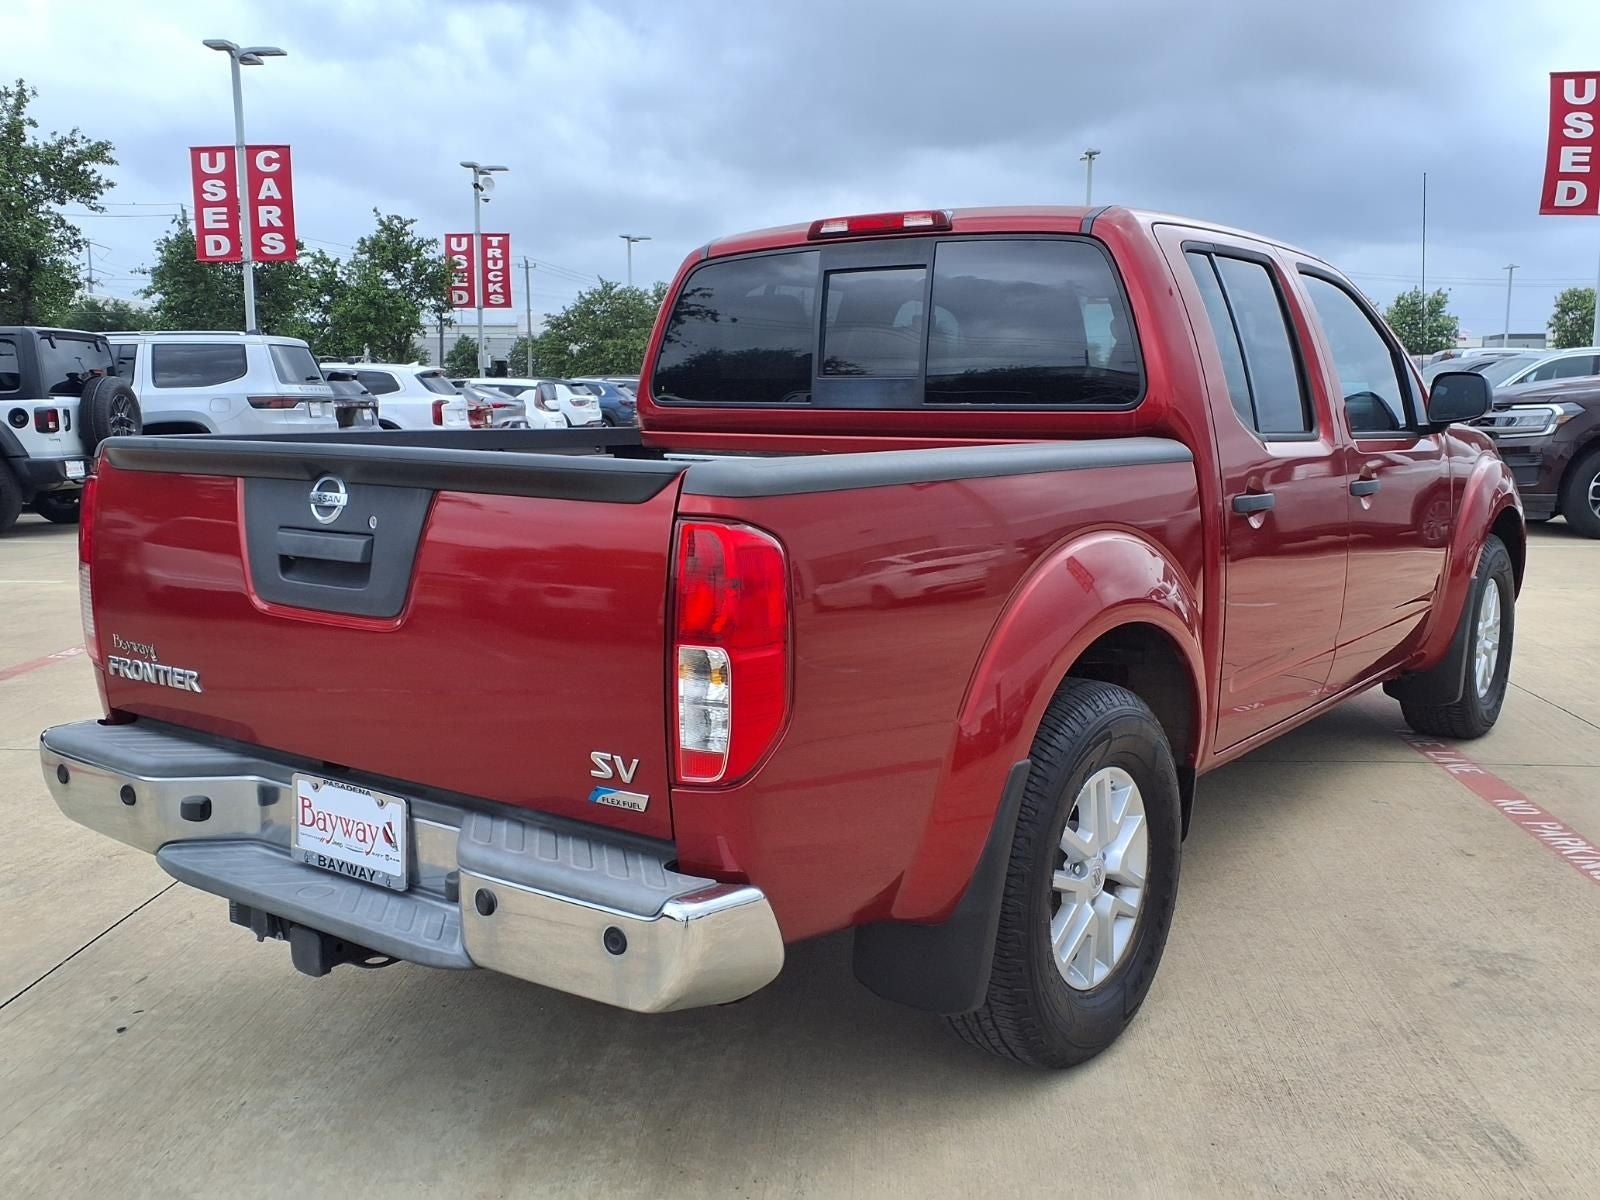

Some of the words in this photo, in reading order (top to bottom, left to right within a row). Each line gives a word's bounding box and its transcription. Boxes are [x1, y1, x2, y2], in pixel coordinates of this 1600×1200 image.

[1553, 78, 1597, 207] USED
[200, 152, 231, 257] USED
[255, 150, 287, 255] CARS
[450, 237, 470, 305] USED
[486, 236, 505, 304] TRUCKS
[108, 655, 202, 693] FRONTIER
[323, 780, 371, 797] PASADENA
[590, 751, 640, 784] SV
[299, 796, 379, 856] Bayway
[602, 797, 621, 806] FLEX
[622, 800, 643, 810] FUEL
[318, 855, 376, 881] BAYWAY
[1494, 799, 1542, 815] NO
[1521, 821, 1600, 881] PARKIN
